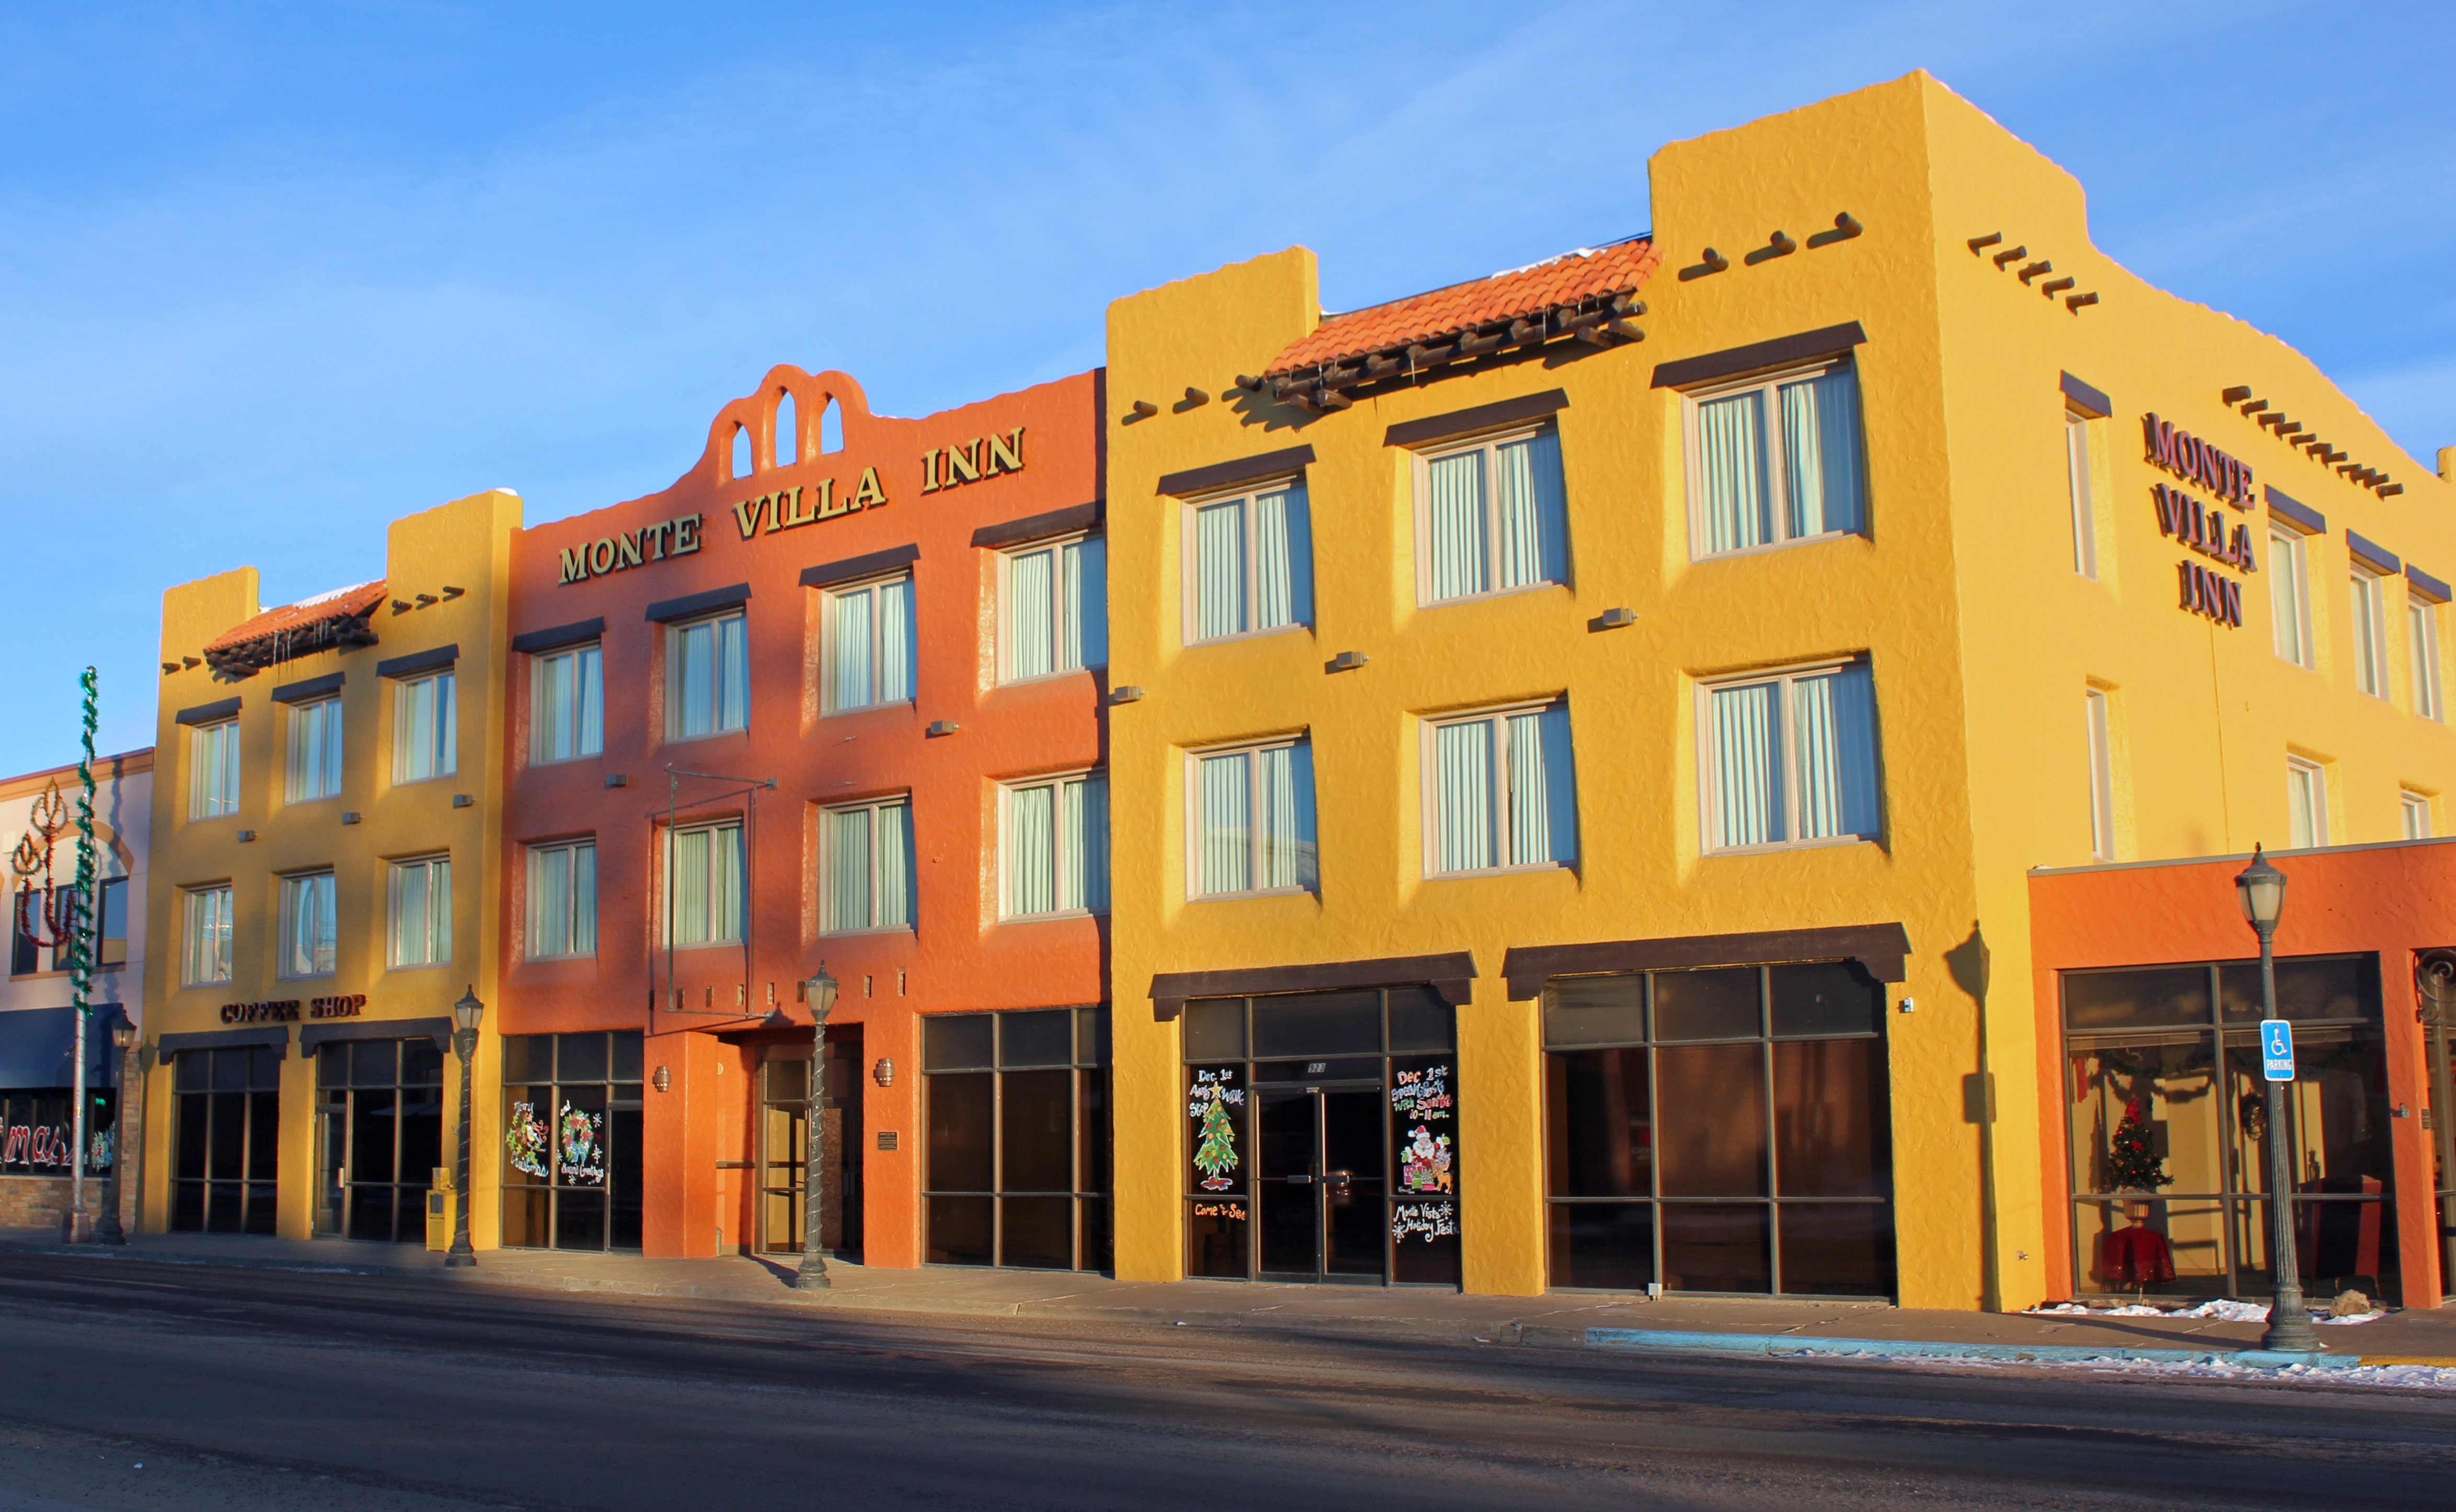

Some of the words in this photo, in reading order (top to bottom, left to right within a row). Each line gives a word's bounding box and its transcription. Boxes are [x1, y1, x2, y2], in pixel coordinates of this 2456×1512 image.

[2141, 412, 2256, 514] MONTE
[558, 513, 702, 586] MONTE
[733, 467, 888, 541] VILLA
[921, 426, 1025, 495] INN
[2150, 483, 2257, 575] VILLA
[2176, 560, 2243, 631] INN
[220, 999, 300, 1025] COFFEE
[310, 994, 366, 1018] SHOP
[1220, 1068, 1233, 1081] 1st
[1309, 1064, 1325, 1072] 923
[1397, 1071, 1421, 1085] Dec
[1426, 1065, 1448, 1081] 1st
[2266, 1059, 2292, 1071] PARKING
[1419, 1202, 1441, 1220] Vista
